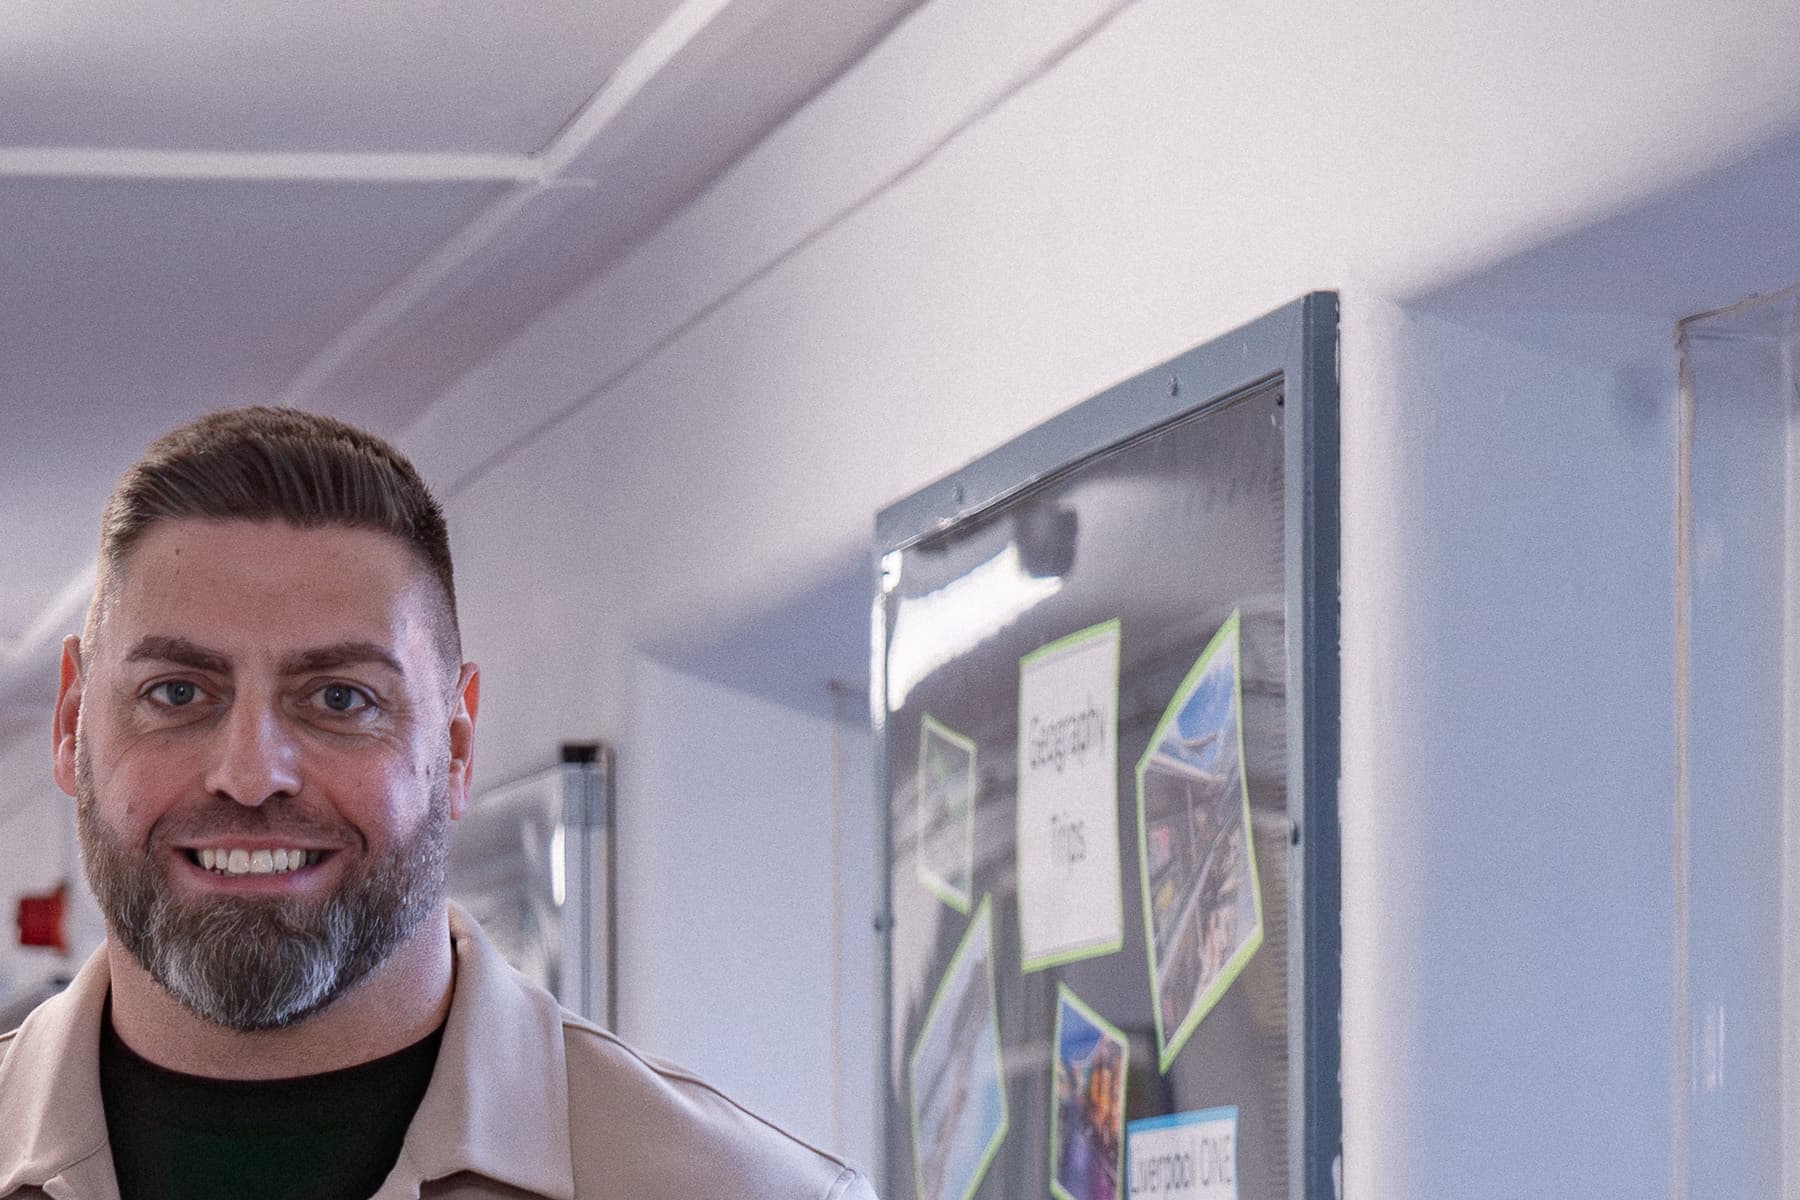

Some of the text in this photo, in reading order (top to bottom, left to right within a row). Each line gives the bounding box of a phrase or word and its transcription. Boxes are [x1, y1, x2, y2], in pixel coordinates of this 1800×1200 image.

[1030, 690, 1108, 773] Geography
[1049, 812, 1088, 874] Trips
[1200, 1134, 1232, 1187] ONE
